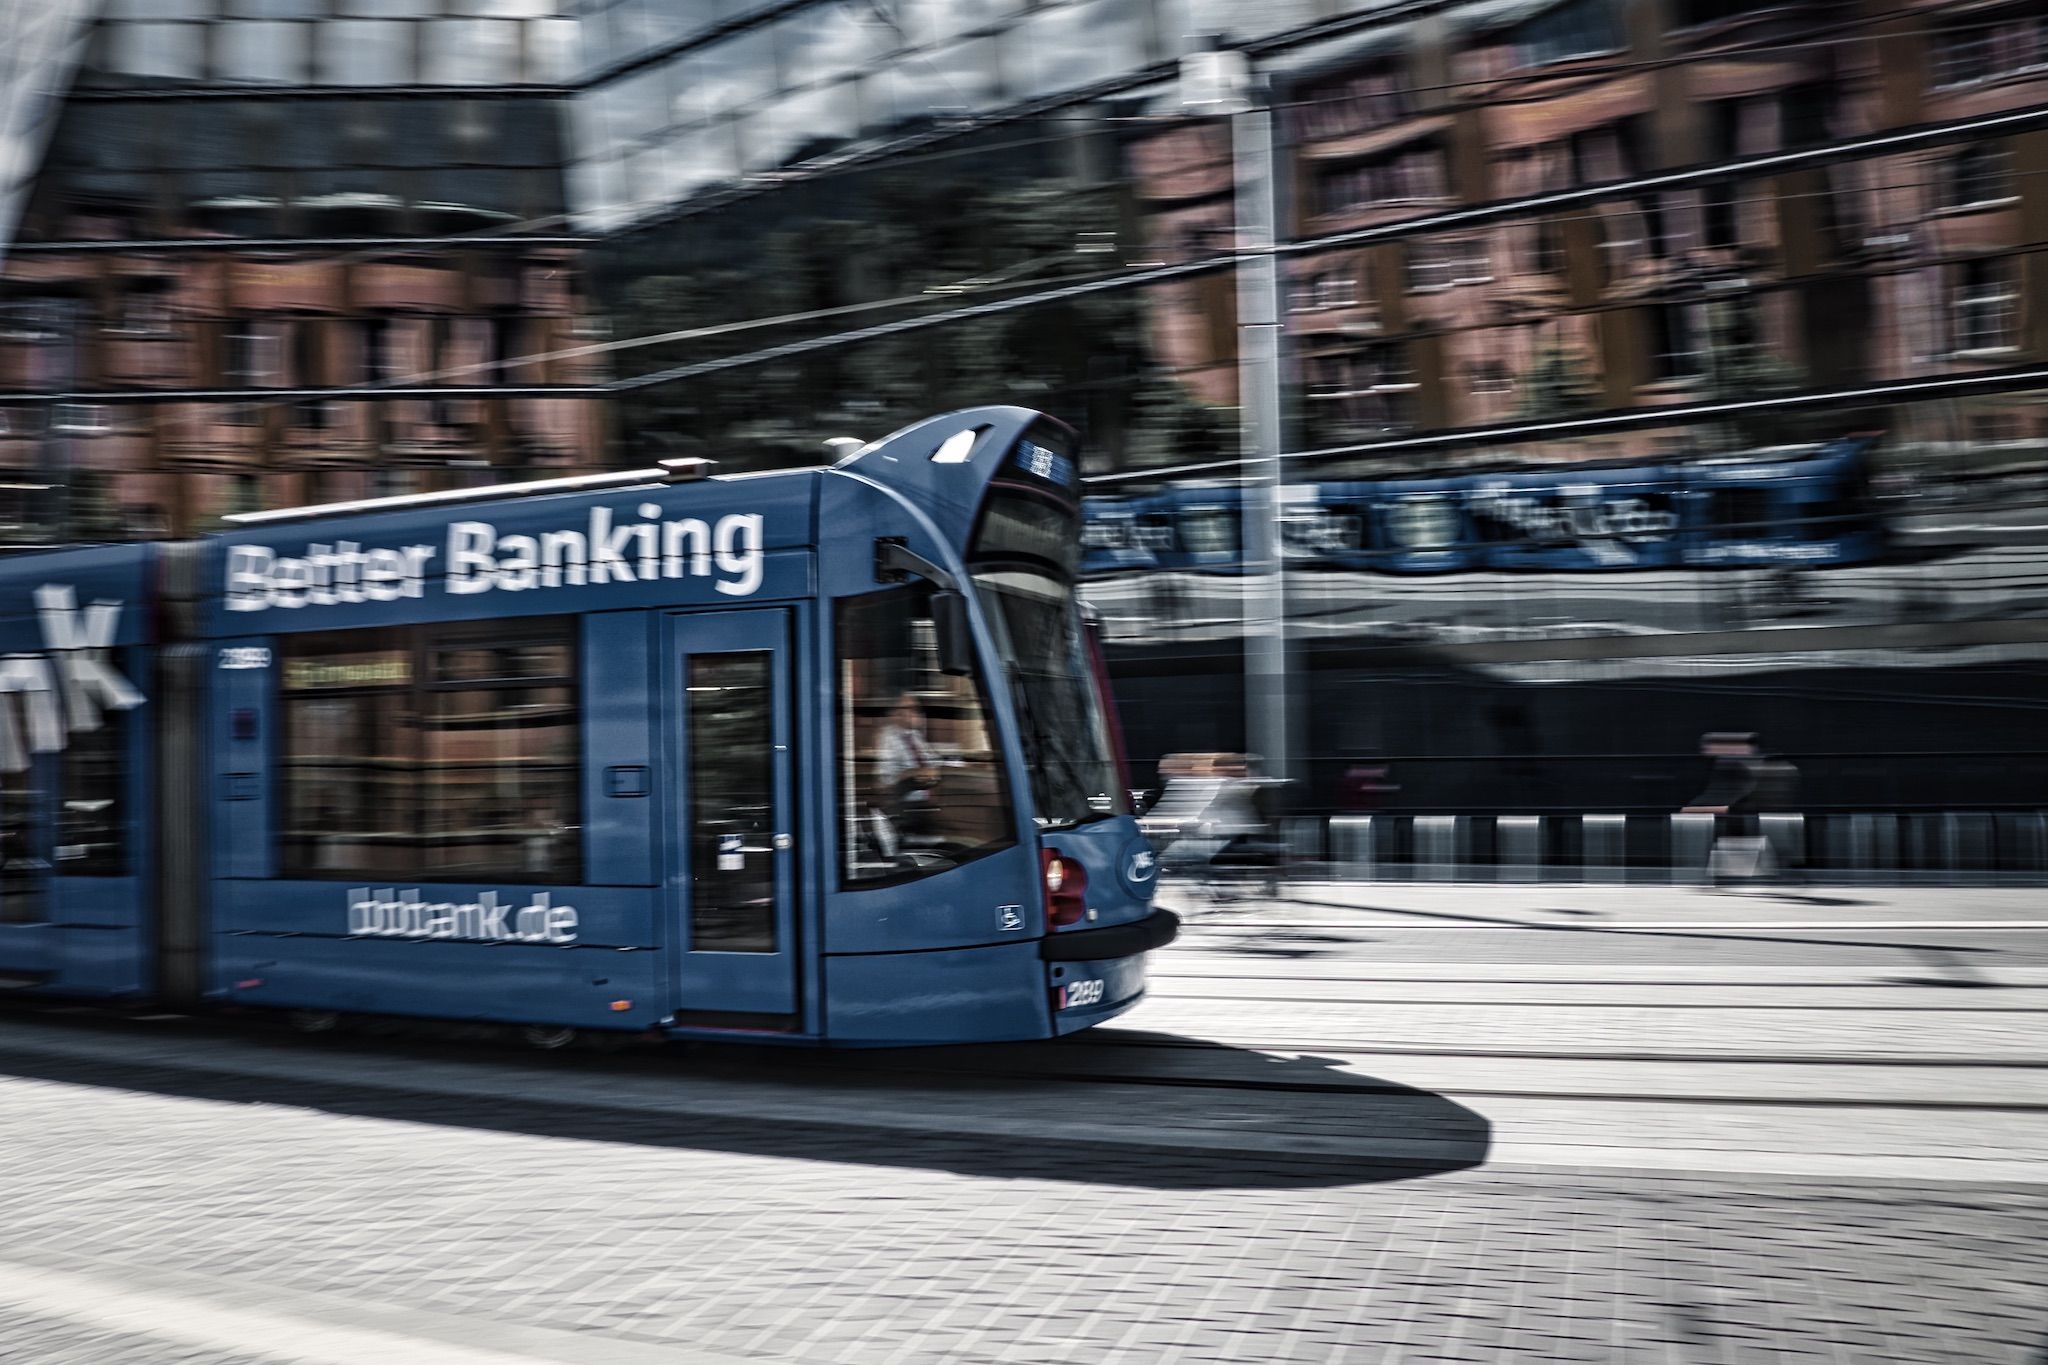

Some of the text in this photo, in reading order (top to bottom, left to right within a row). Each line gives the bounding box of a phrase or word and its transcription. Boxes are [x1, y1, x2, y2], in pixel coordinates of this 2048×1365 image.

[225, 502, 764, 612] Better Banking
[347, 887, 578, 943] bbbank.de
